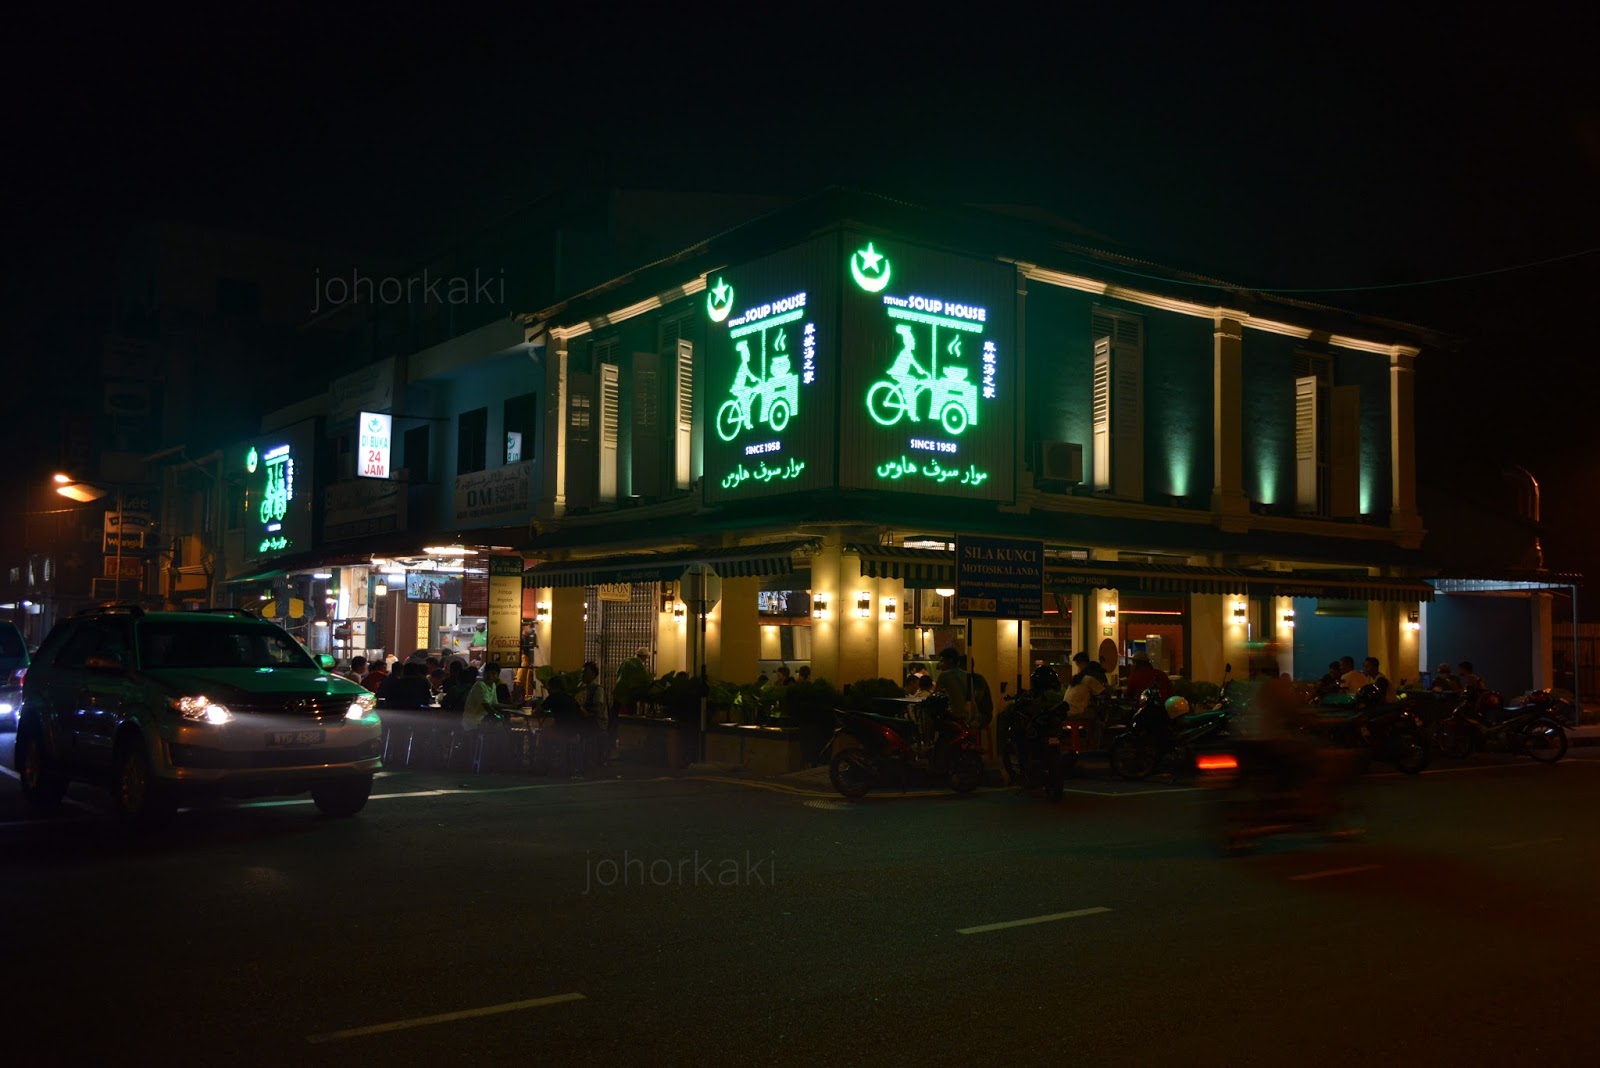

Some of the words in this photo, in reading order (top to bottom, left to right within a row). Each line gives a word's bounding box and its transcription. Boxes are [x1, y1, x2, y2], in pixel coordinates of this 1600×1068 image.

[728, 317, 746, 328] muar
[746, 304, 771, 322] SOUP
[772, 292, 806, 314] HOUSE
[883, 296, 908, 307] muar
[908, 295, 942, 313] SOUP
[945, 302, 986, 321] HOUSE
[370, 435, 388, 449] BUKA
[746, 444, 764, 455] SINCE
[764, 441, 780, 452] 1958
[910, 439, 935, 450] SINCE
[937, 442, 957, 453] 1958
[368, 450, 381, 463] 24
[364, 464, 384, 476] JAM
[965, 546, 994, 560] SILA
[996, 548, 1038, 562] KUNCI
[962, 564, 1015, 575] MOTOSIKAL
[1015, 567, 1039, 576] ANDA
[601, 585, 628, 593] KUPON
